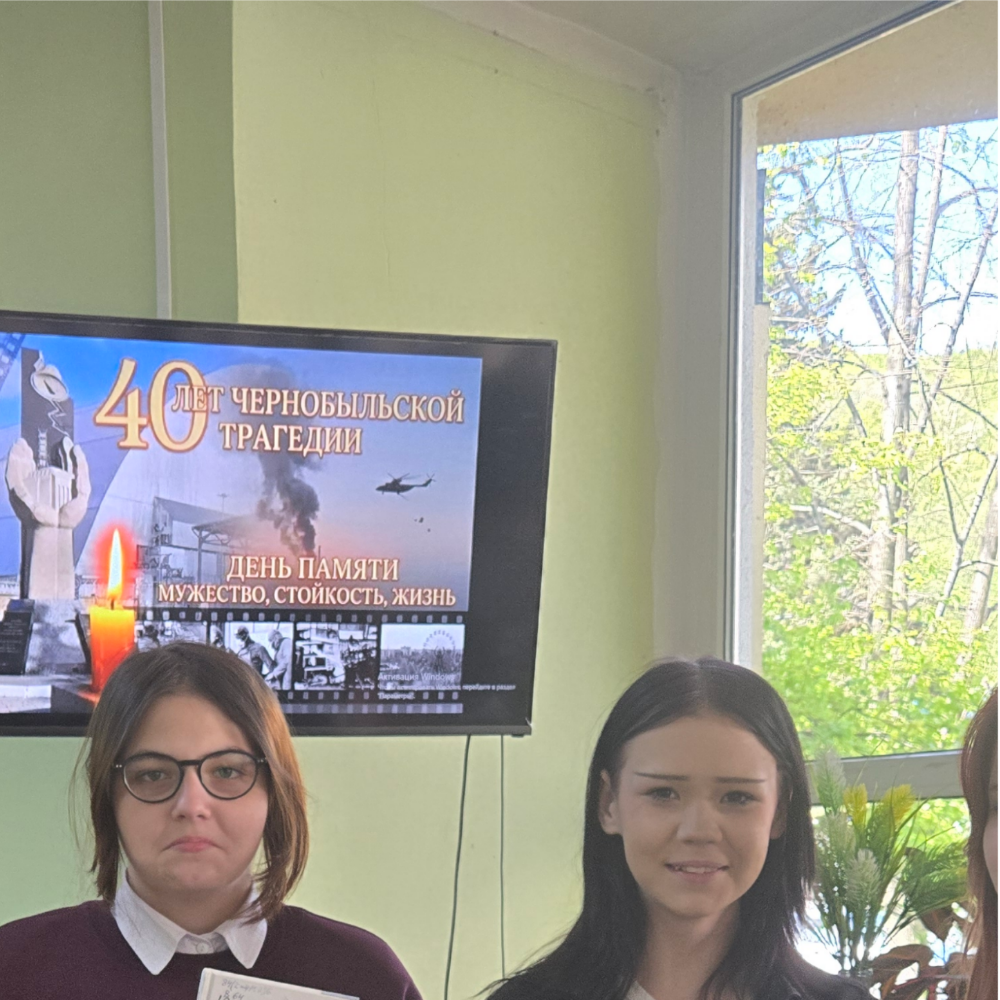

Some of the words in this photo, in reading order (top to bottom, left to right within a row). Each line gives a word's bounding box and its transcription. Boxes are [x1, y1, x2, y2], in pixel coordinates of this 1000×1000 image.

[94, 358, 209, 452] 40
[171, 384, 224, 413] ЛЕТ
[231, 387, 465, 423] ЧЕРНОБЫЛЬСКОЙ
[219, 422, 362, 457] ТРАГЕДИИ
[227, 555, 292, 582] ДЕНЬ
[298, 556, 399, 581] ПАМЯТИ
[158, 583, 270, 607] МУЖЕСТВО,
[273, 581, 388, 608] СТОЙКОСТЬ,
[392, 588, 456, 606] ЖИЗНЬ
